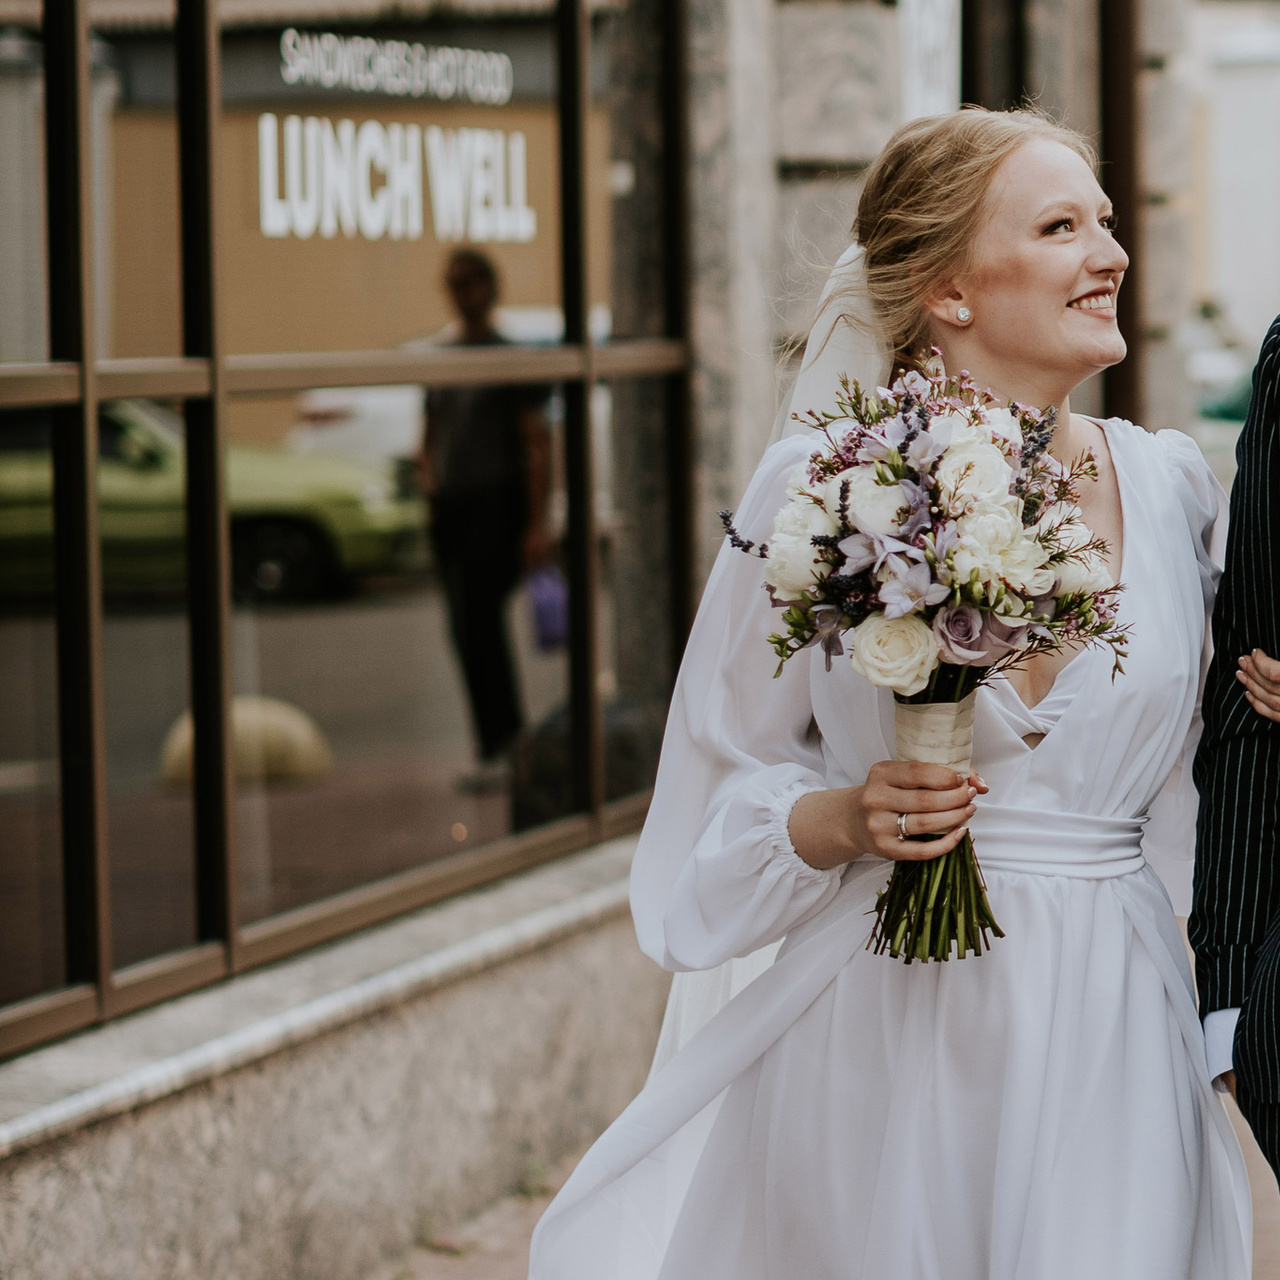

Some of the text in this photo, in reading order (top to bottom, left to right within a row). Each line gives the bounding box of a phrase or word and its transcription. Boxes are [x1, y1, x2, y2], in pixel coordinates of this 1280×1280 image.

[280, 28, 411, 96] SANDWICHES
[462, 49, 513, 105] FOOD
[258, 112, 537, 242] LUNCH WELL
